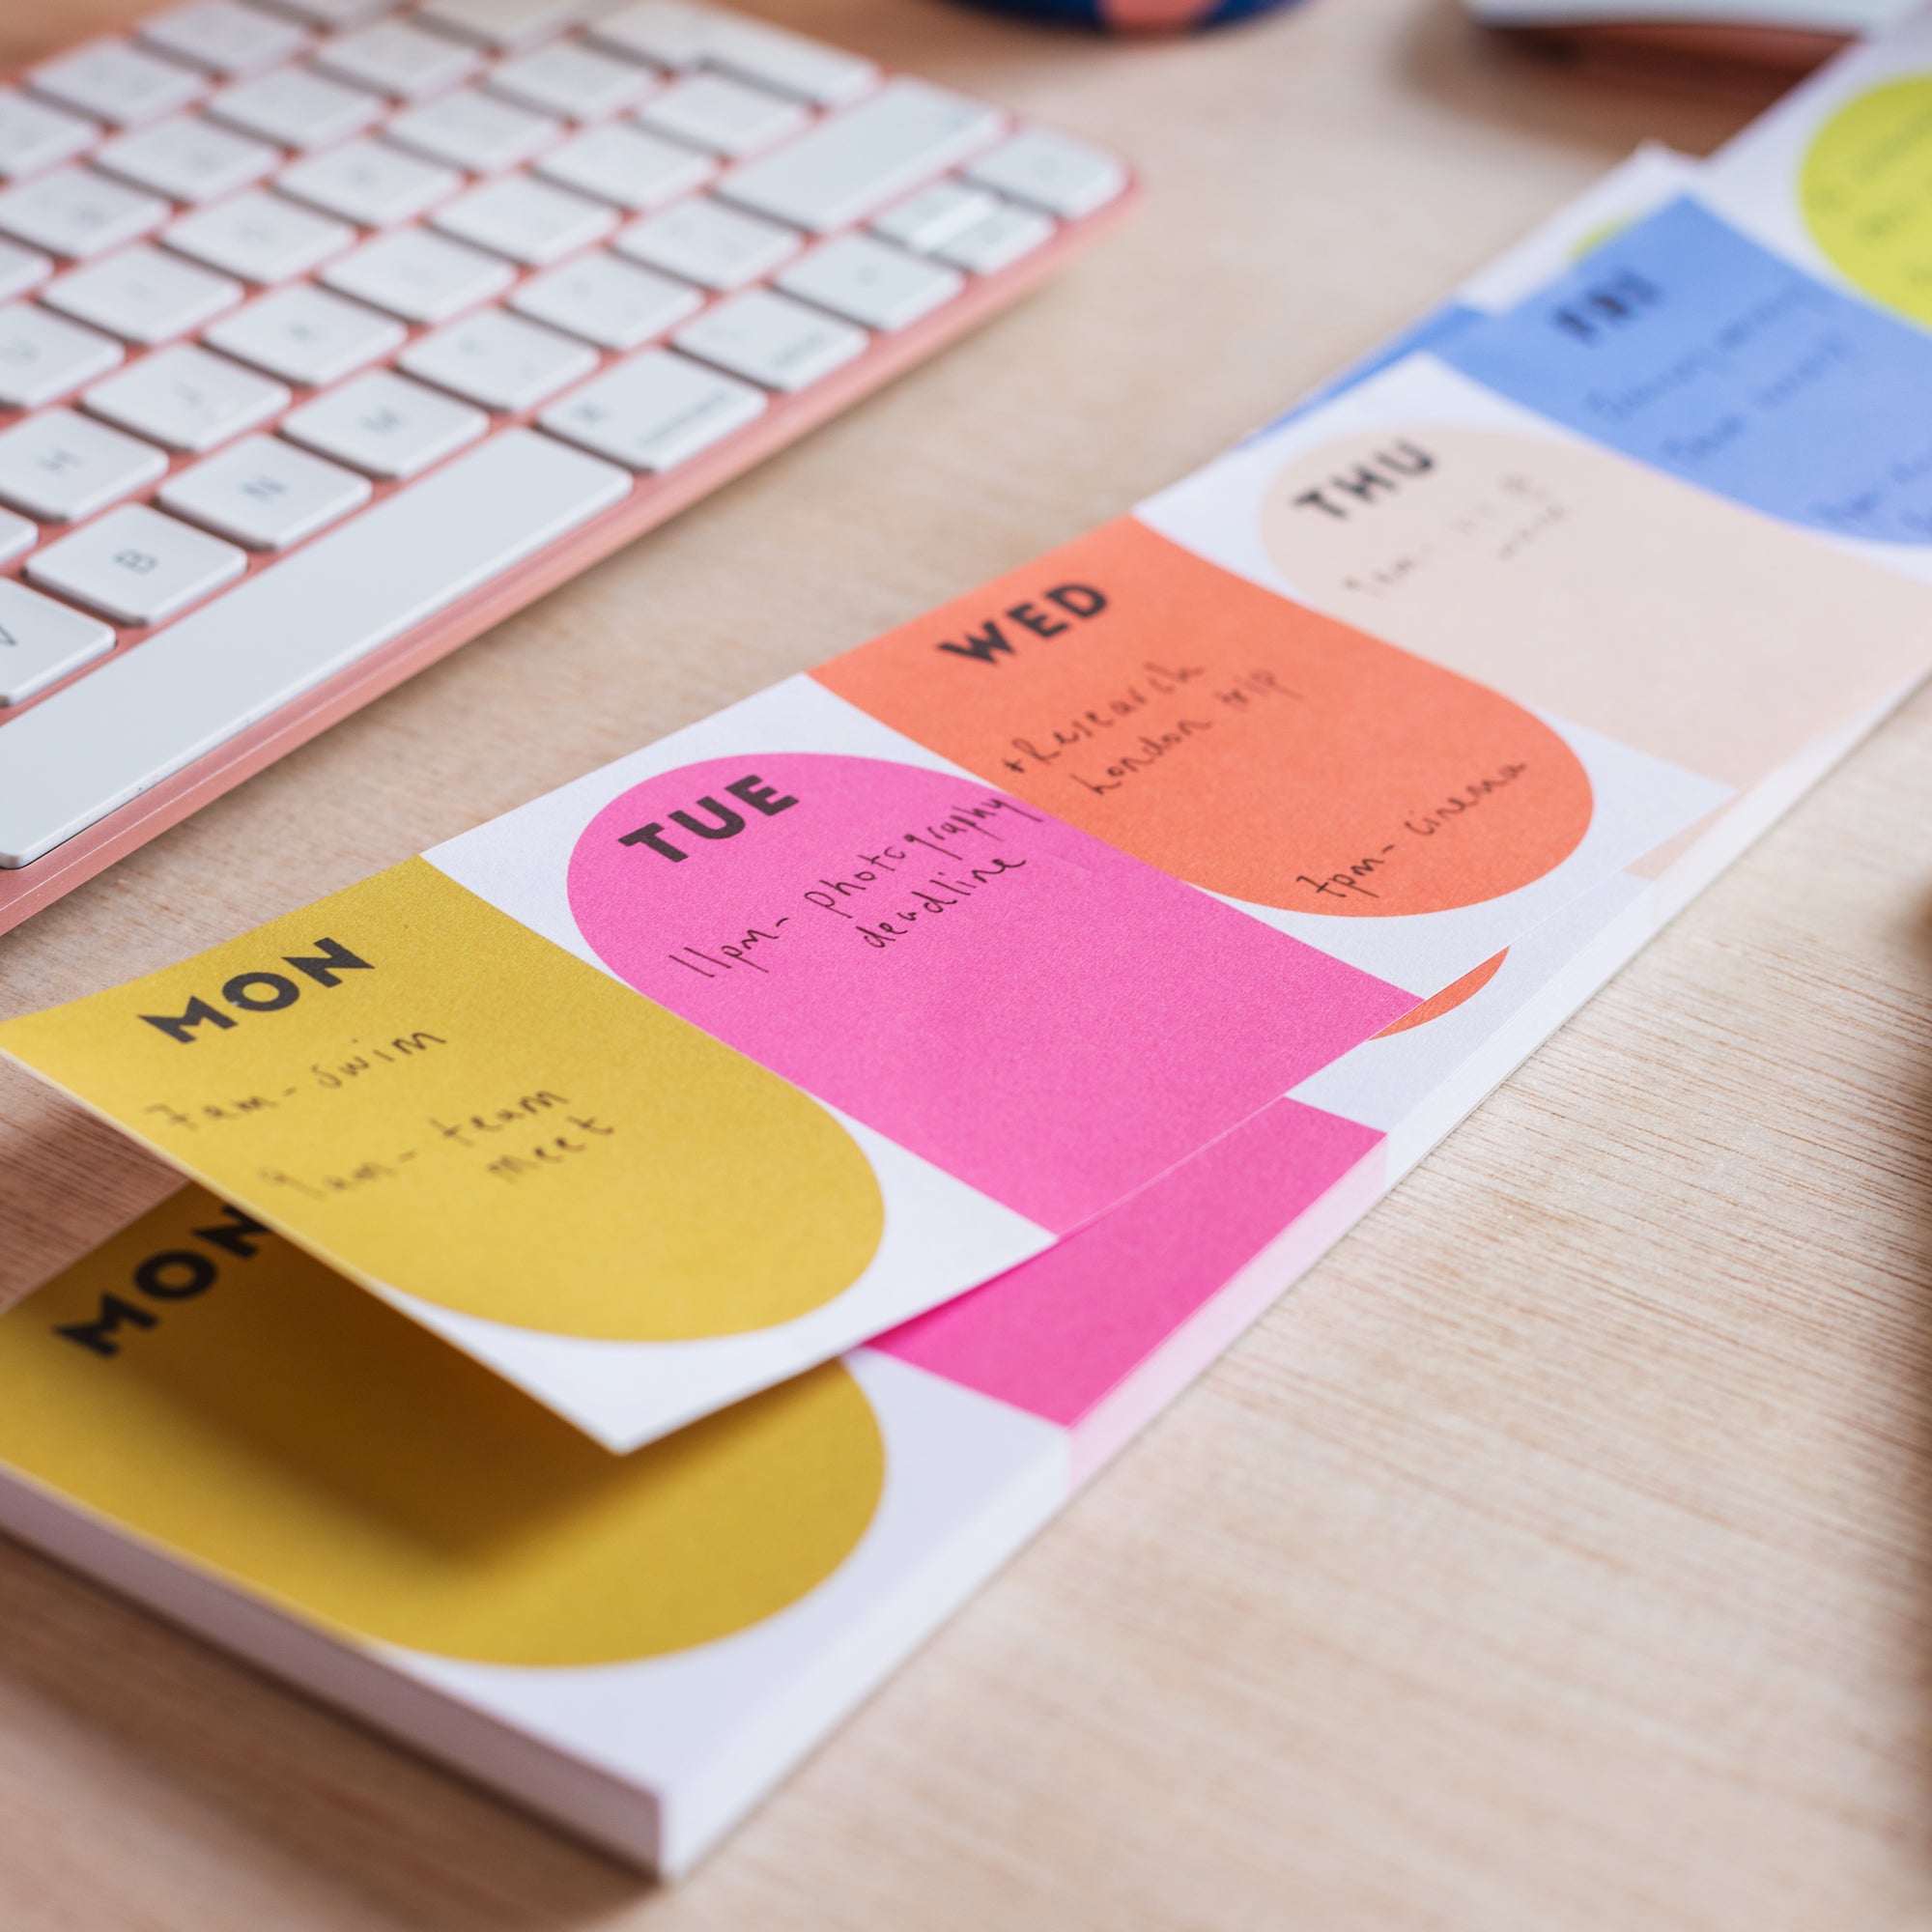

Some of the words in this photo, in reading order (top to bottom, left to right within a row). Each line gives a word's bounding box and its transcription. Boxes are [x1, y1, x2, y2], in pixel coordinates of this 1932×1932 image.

[1293, 440, 1437, 520] THU
[112, 548, 158, 575] B
[935, 582, 1109, 666] WED
[1069, 720, 1214, 795] London
[617, 774, 800, 864] TUE
[1404, 762, 1527, 837] cinema
[804, 796, 1044, 920] photography
[855, 854, 1028, 950] deadline
[136, 936, 376, 1044] MON
[311, 1031, 446, 1090] swim
[428, 1090, 569, 1148] team
[487, 1115, 614, 1185] meet
[51, 1204, 274, 1360] MON
